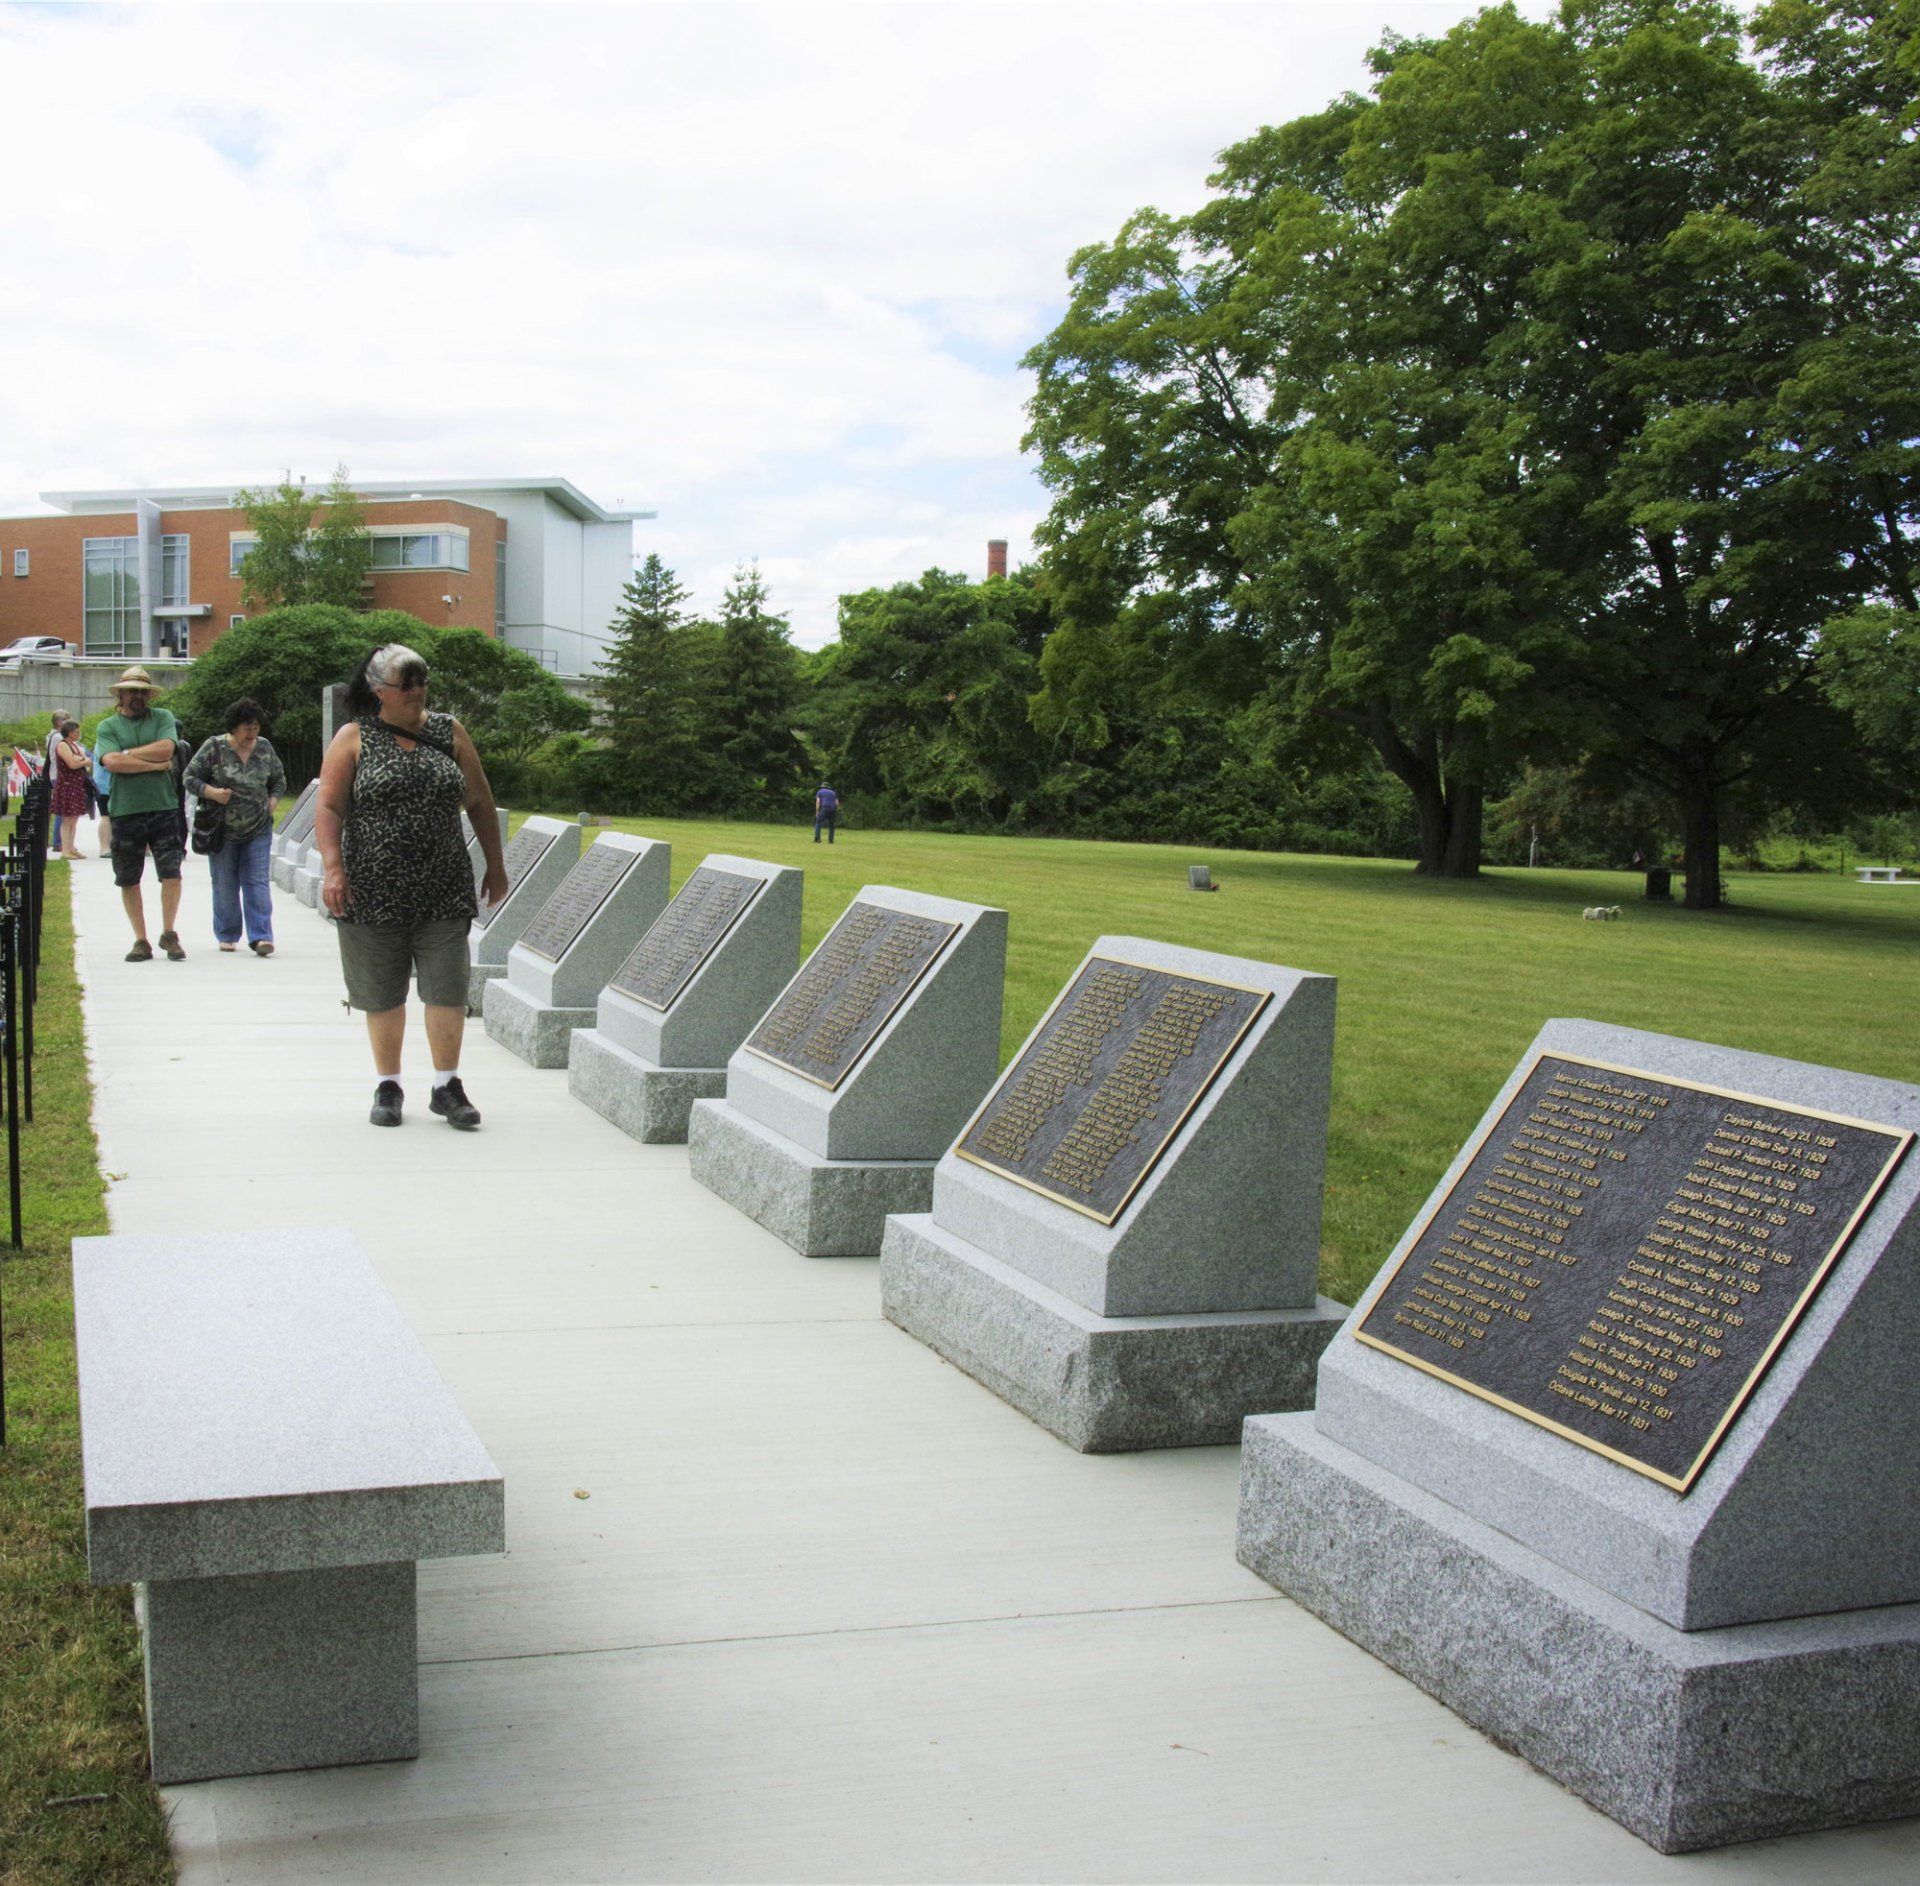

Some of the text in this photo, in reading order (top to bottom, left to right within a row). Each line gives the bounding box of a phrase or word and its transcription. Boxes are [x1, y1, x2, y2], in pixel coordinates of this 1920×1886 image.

[1713, 1128, 1741, 1142] Dennis
[1742, 1135, 1772, 1149] O'Brien
[1772, 1142, 1790, 1155] Sep
[1789, 1146, 1803, 1158] 18,
[1723, 1114, 1753, 1128] Clayton
[1753, 1121, 1782, 1134] Barker
[1779, 1127, 1799, 1140] Aug
[1797, 1131, 1811, 1142] 23,
[1694, 1158, 1714, 1169] John
[1748, 1172, 1764, 1182] Jan
[1774, 1178, 1797, 1190] 1929
[1703, 1143, 1734, 1157] Russell
[1732, 1150, 1741, 1159] P.
[1772, 1160, 1789, 1171] Oct
[1788, 1164, 1797, 1174] 7,
[1674, 1187, 1703, 1201] Joseph
[1733, 1203, 1750, 1214] Jan
[1749, 1208, 1762, 1220] 21,
[1763, 1212, 1787, 1224] 1929
[1683, 1172, 1709, 1185] Albert
[1707, 1178, 1740, 1194] Edward
[1760, 1193, 1777, 1204] Jan
[1777, 1197, 1790, 1209] 19,
[1792, 1201, 1816, 1214] 1929
[1656, 1216, 1792, 1264] George Wesley Henry Apr 25, 1929
[1665, 1201, 1770, 1238] Edgar McKay Mar 31, 1929
[1646, 1231, 1674, 1246] Joseph
[1706, 1250, 1726, 1263] May
[1724, 1256, 1736, 1267] 11,
[1738, 1260, 1761, 1273] 1929
[1653, 1270, 1662, 1280] A.
[1689, 1281, 1707, 1294] Dec
[1707, 1288, 1715, 1298] 4,
[1716, 1291, 1739, 1304] 1929
[1666, 1255, 1677, 1266] W.
[1677, 1259, 1706, 1275] Carson
[1706, 1268, 1723, 1282] Sep
[1723, 1274, 1736, 1287] 12,
[1737, 1279, 1761, 1292] 1929
[1607, 1290, 1723, 1338] Kenneth Roy Taft Feb 27, 1930
[1616, 1275, 1638, 1289] Hugh
[1638, 1283, 1659, 1297] Cook
[1657, 1290, 1696, 1310] Anderson
[1695, 1303, 1711, 1315] Jan
[1720, 1312, 1744, 1326] 1930
[1597, 1305, 1625, 1322] Joseph
[1624, 1315, 1634, 1325] E.
[1666, 1331, 1686, 1345] May
[1684, 1338, 1697, 1351] 30,
[1698, 1343, 1721, 1357] 1930
[1608, 1328, 1616, 1337] J.
[1616, 1331, 1645, 1349] Hartley
[1642, 1342, 1661, 1356] Aug
[1659, 1348, 1673, 1361] 22,
[1673, 1353, 1696, 1368] 1930
[1568, 1350, 1668, 1397] Hilliard White Nov 29, 1930
[1579, 1334, 1678, 1381] Willis C. Post Sep 21, 1930
[1549, 1380, 1650, 1431] Octave Lemay Mar 17, 1931
[1558, 1365, 1589, 1384] Douglas
[1588, 1377, 1597, 1388] R.
[1622, 1392, 1638, 1405] Jan
[1637, 1399, 1650, 1412] 12,
[1651, 1405, 1673, 1420] 1931
